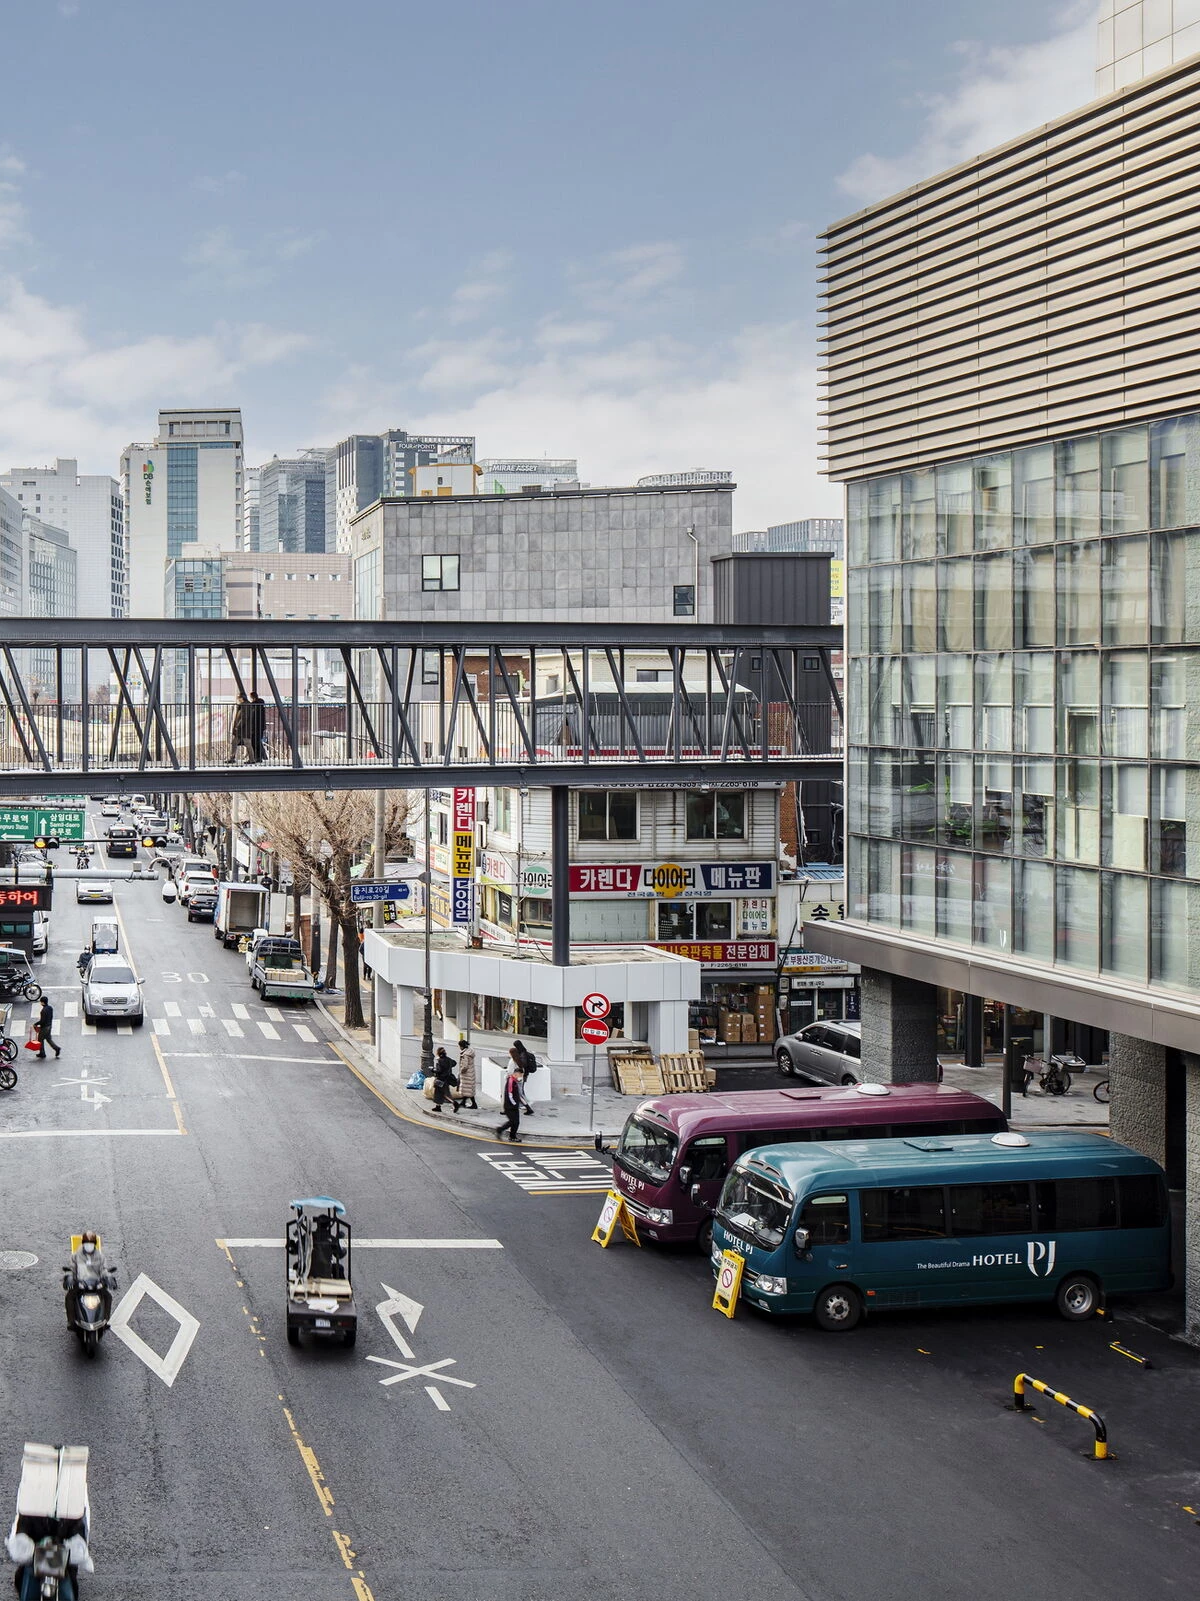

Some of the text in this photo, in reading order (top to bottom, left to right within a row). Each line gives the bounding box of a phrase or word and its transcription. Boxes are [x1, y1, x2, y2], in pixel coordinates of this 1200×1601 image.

[491, 463, 538, 472] MIRAE ASSET
[49, 813, 80, 822] 삼일대로
[456, 788, 473, 830] 카렌다
[455, 835, 472, 875] 메뉴판
[580, 868, 632, 890] 카렌다
[643, 867, 696, 889] 다이어리
[710, 867, 761, 889] 메뉴판
[742, 910, 768, 920] 다이어리
[726, 944, 769, 959] 전문업체
[160, 971, 211, 984] 30
[620, 1171, 645, 1191] HOTEL PJ
[723, 1230, 753, 1255] HOTEL PJ
[917, 1262, 928, 1270] The
[972, 1253, 1022, 1267] HOTEL
[1027, 1240, 1056, 1277] PJ
